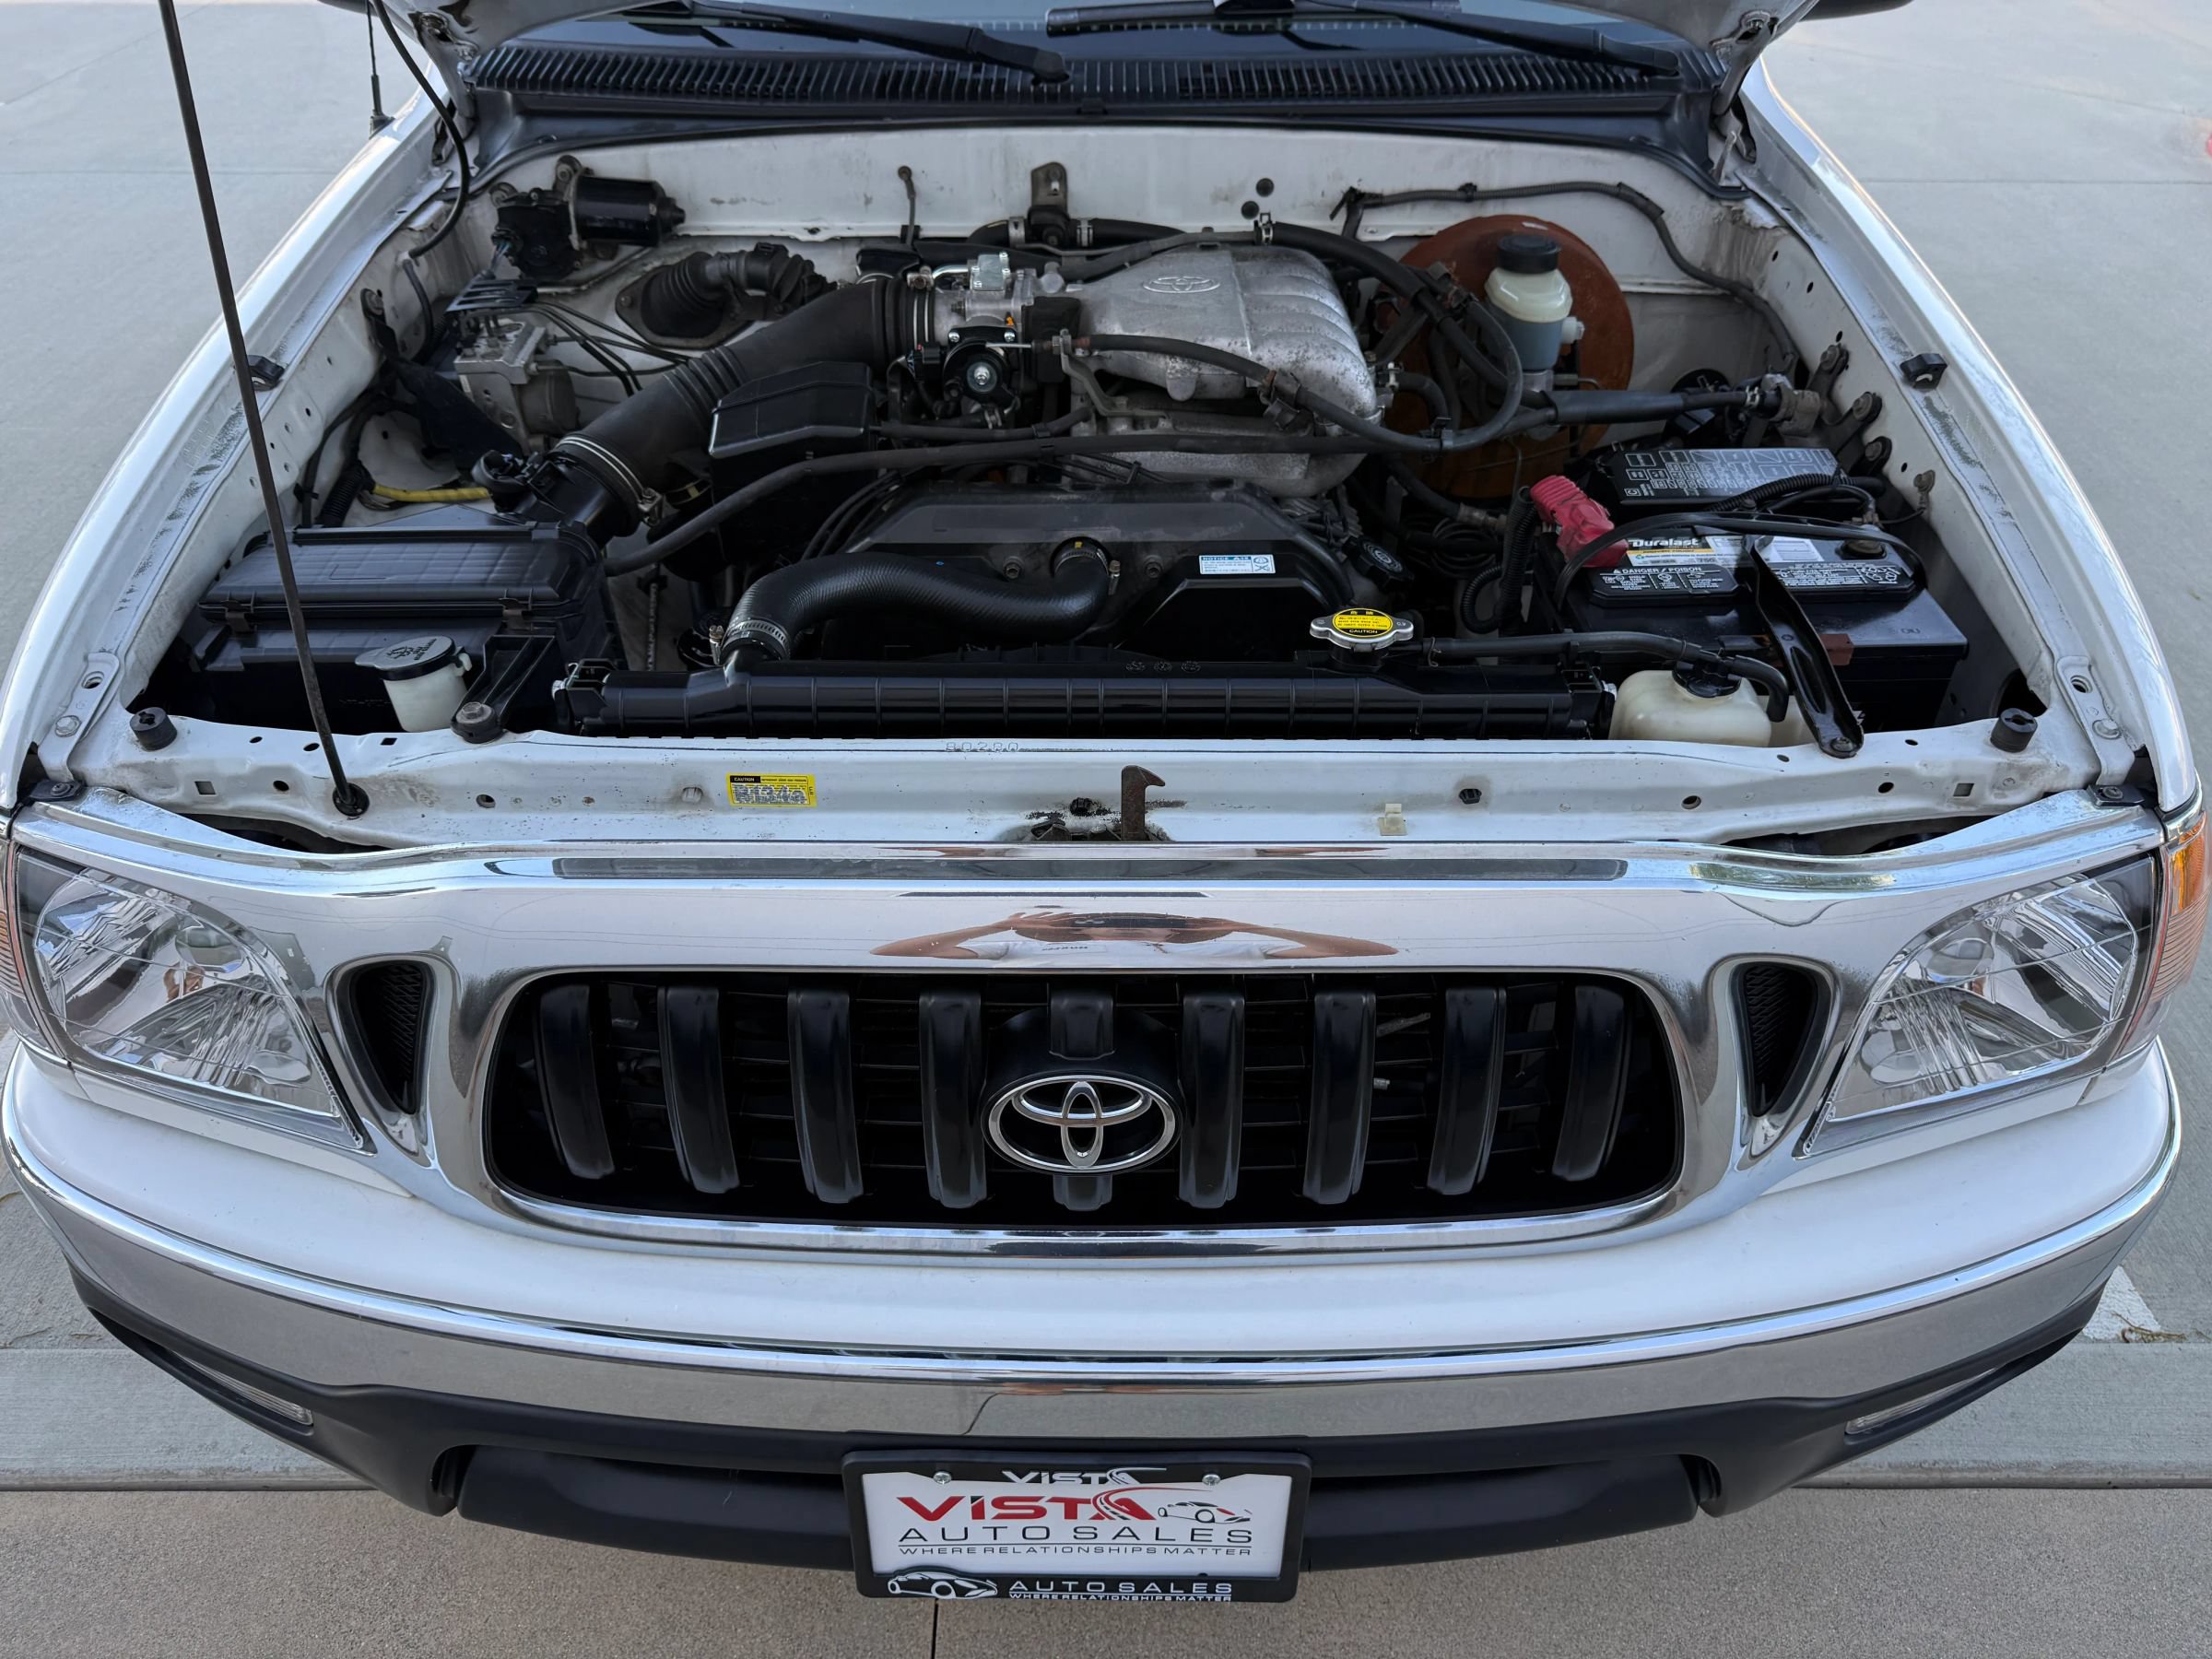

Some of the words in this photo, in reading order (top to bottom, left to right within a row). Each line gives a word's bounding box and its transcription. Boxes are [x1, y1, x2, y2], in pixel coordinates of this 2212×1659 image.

[1629, 538, 1700, 548] Duralast
[1002, 1469, 1143, 1485] VISTA
[897, 1489, 1158, 1522] VISTA
[899, 1526, 1051, 1543] AUTO
[1073, 1526, 1253, 1544] SALES
[899, 1547, 977, 1556] WHERE
[983, 1546, 1157, 1555] RELATIONSHIPS
[1164, 1547, 1251, 1556] MATTER
[1009, 1581, 1106, 1593] AUTO
[1118, 1583, 1232, 1594] SALES
